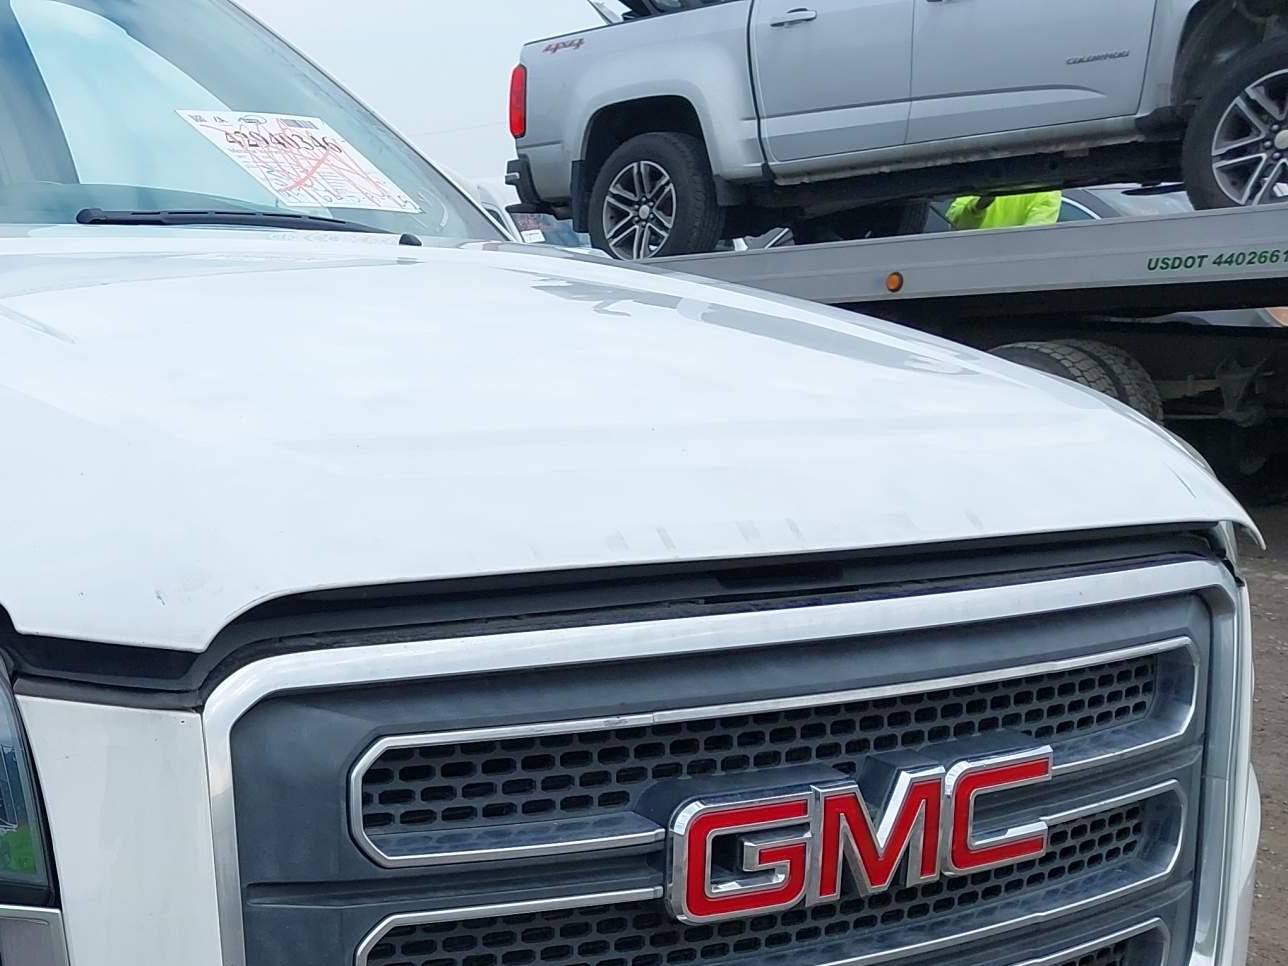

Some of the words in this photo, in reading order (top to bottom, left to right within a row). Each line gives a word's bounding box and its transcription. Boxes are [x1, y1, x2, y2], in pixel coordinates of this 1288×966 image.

[224, 130, 343, 153] 42940346
[1146, 254, 1209, 271] USDOT
[1212, 249, 1288, 267] 4402661
[669, 744, 1054, 928] GMC
